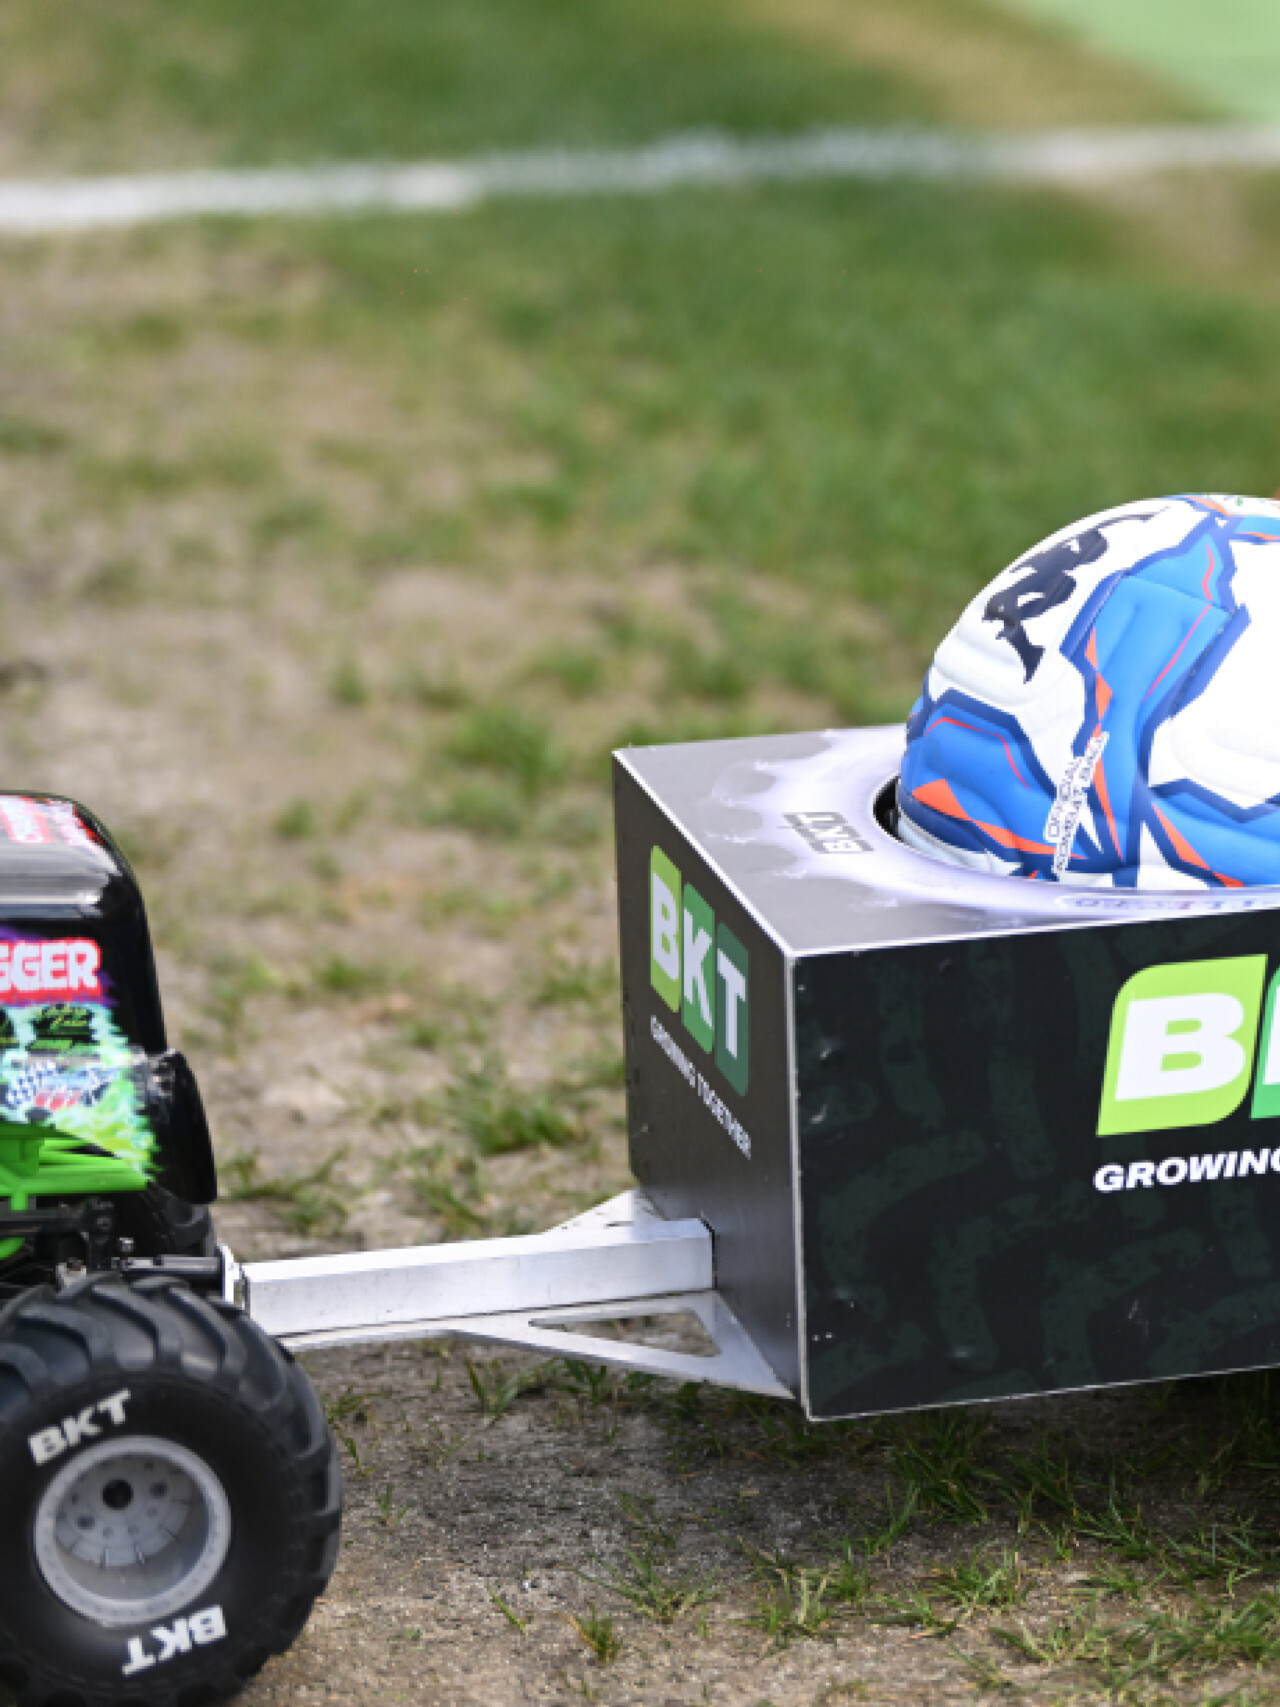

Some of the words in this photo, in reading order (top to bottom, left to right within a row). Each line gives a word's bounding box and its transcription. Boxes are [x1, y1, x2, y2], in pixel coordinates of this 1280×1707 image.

[652, 871, 747, 1061] BKT
[28, 1388, 132, 1465] BKT
[121, 1604, 228, 1677] BKT
